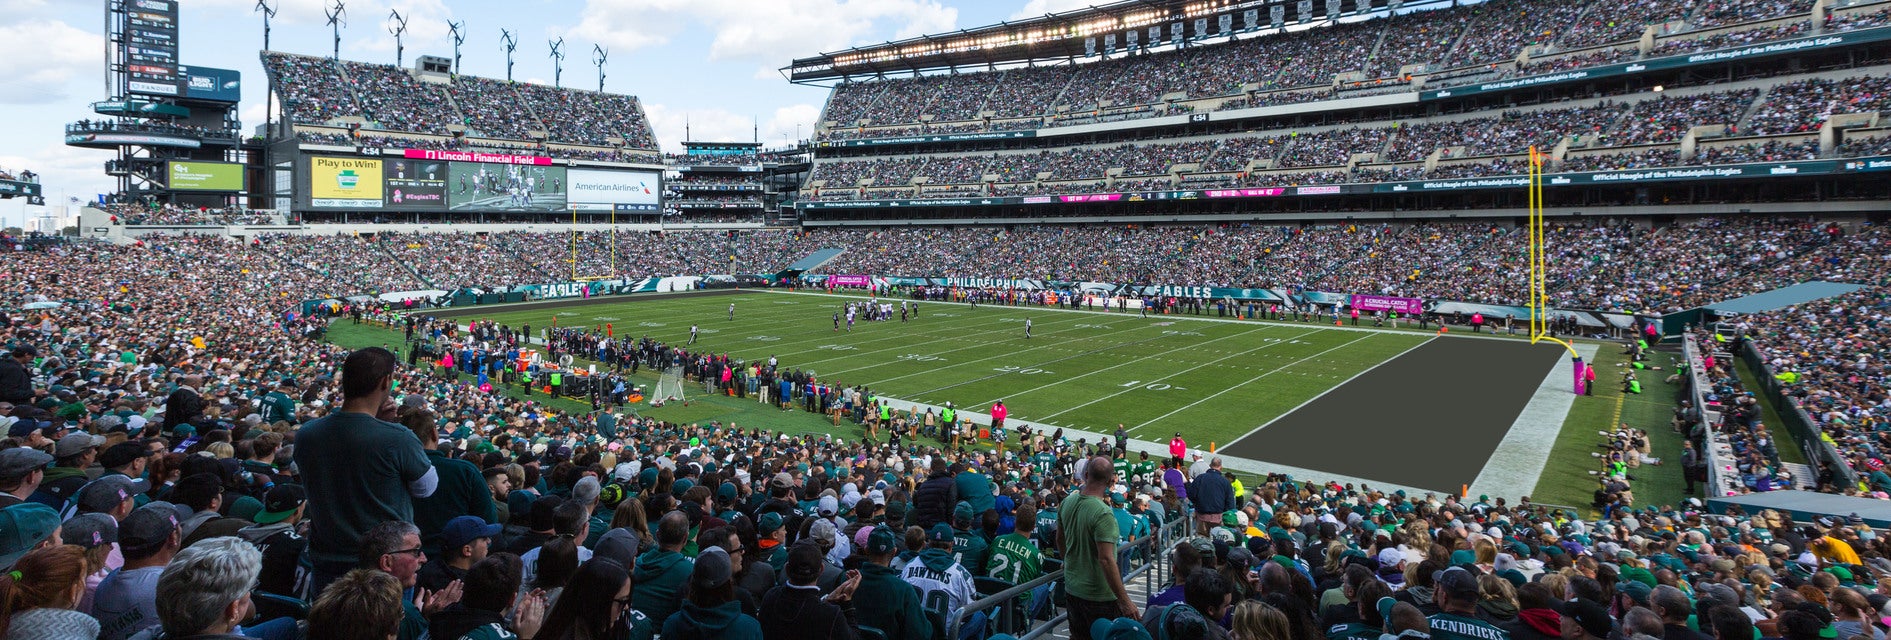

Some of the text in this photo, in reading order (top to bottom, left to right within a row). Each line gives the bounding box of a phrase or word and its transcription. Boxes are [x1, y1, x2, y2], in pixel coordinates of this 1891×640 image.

[1688, 53, 1717, 63] Official
[1765, 40, 1814, 52] Philadelphia
[1815, 37, 1843, 46] Eagles
[1481, 83, 1500, 91] Official
[1535, 74, 1569, 83] Philadelphia
[361, 148, 380, 156] 4:54
[438, 151, 535, 164] Lincoln Financial Field
[317, 159, 377, 169] Play to Win!
[1644, 171, 1652, 179] of
[1667, 169, 1714, 178] Philadelphia
[1715, 168, 1742, 176] Eagles
[575, 182, 639, 192] American Airlines
[947, 277, 1023, 290] PHILADELPHIA
[1153, 285, 1212, 299] EAGLES
[1118, 380, 1172, 391] 10
[1063, 463, 1073, 475] 11
[953, 537, 968, 547] NTZ
[997, 538, 1032, 559] E.ALLEN
[989, 553, 1022, 584] 21
[908, 566, 952, 585] DAWKINS
[1430, 618, 1505, 640] KENDRICKS
